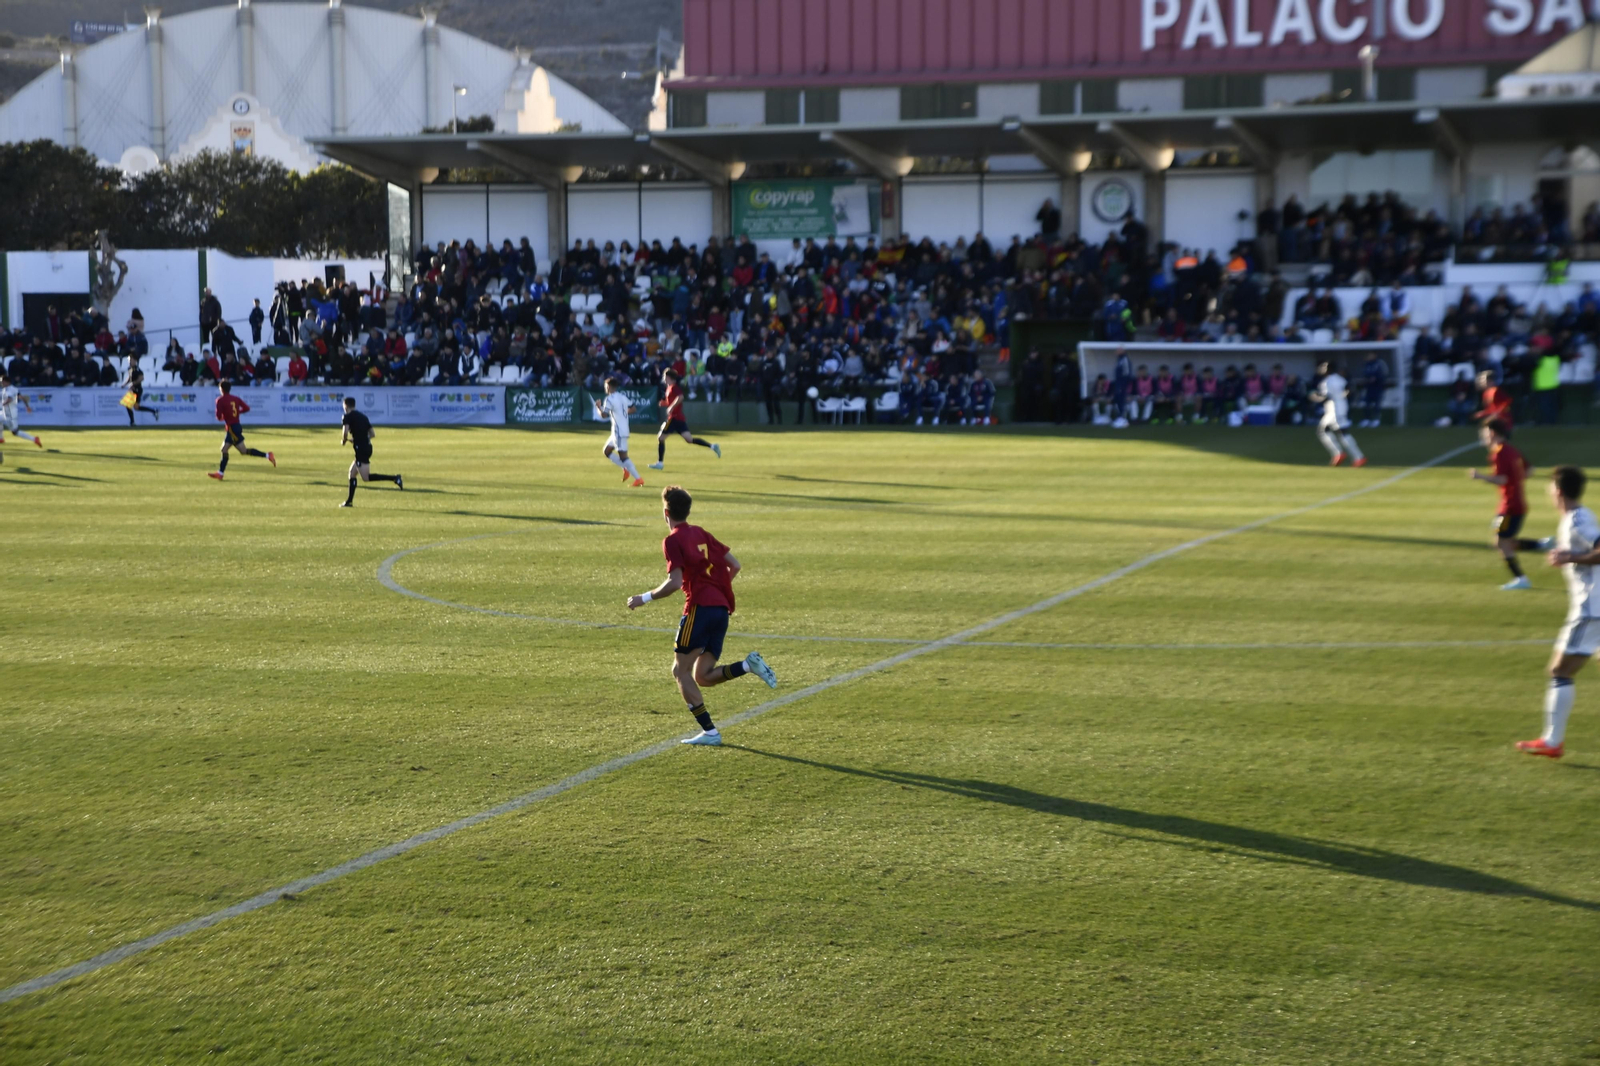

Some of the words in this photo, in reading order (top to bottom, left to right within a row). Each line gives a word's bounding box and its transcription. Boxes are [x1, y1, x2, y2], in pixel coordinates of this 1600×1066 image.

[1142, 0, 1446, 50] PALACIO
[1485, 0, 1600, 35] SA
[230, 401, 238, 418] 3
[431, 404, 496, 413] TORREMOLINOS
[697, 543, 714, 577] 7
